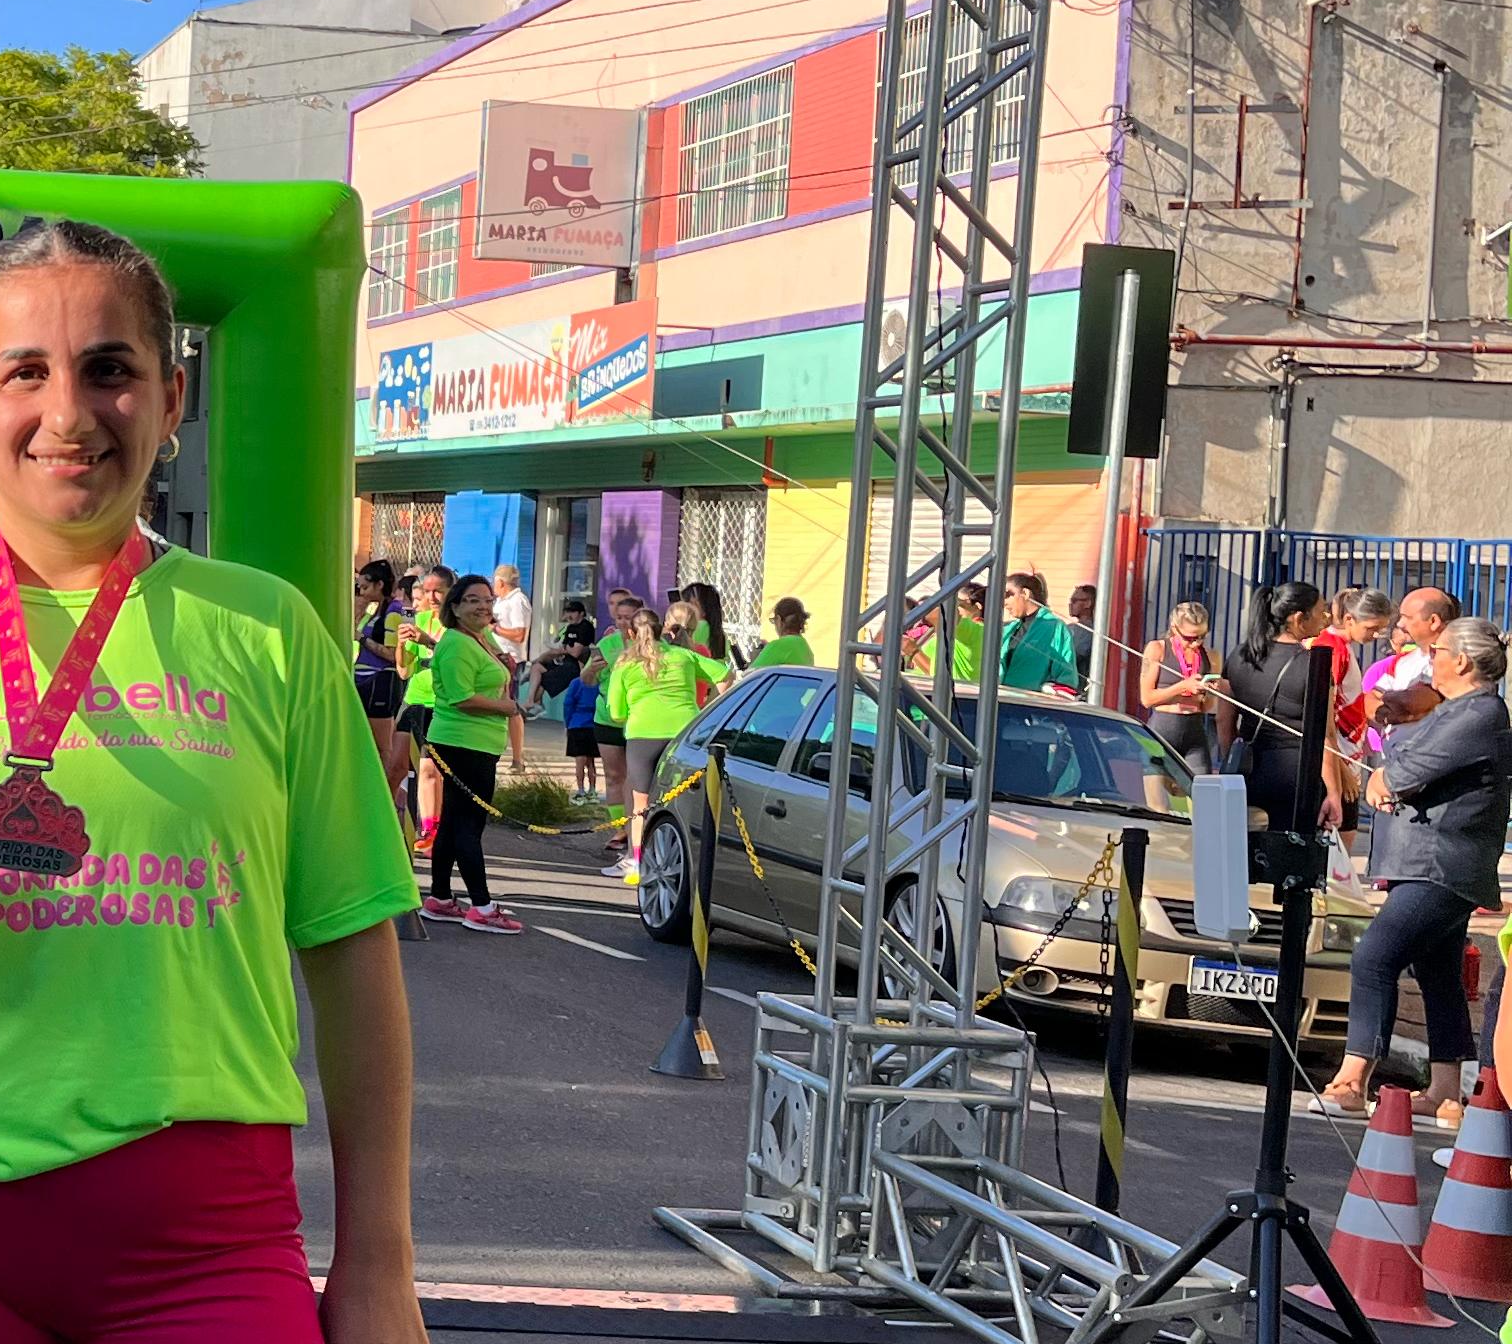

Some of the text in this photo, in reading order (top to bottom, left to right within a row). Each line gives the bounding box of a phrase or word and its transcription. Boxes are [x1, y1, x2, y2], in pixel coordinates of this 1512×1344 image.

[488, 222, 625, 250] MARIA FUMAÇA
[569, 317, 609, 373] Mix
[432, 351, 564, 418] MARIA FUMAÇA
[95, 729, 125, 748] da
[128, 733, 164, 748] sua
[35, 845, 64, 860] DAS
[138, 852, 207, 890] DAS
[1199, 970, 1276, 998] IKZ3C0
